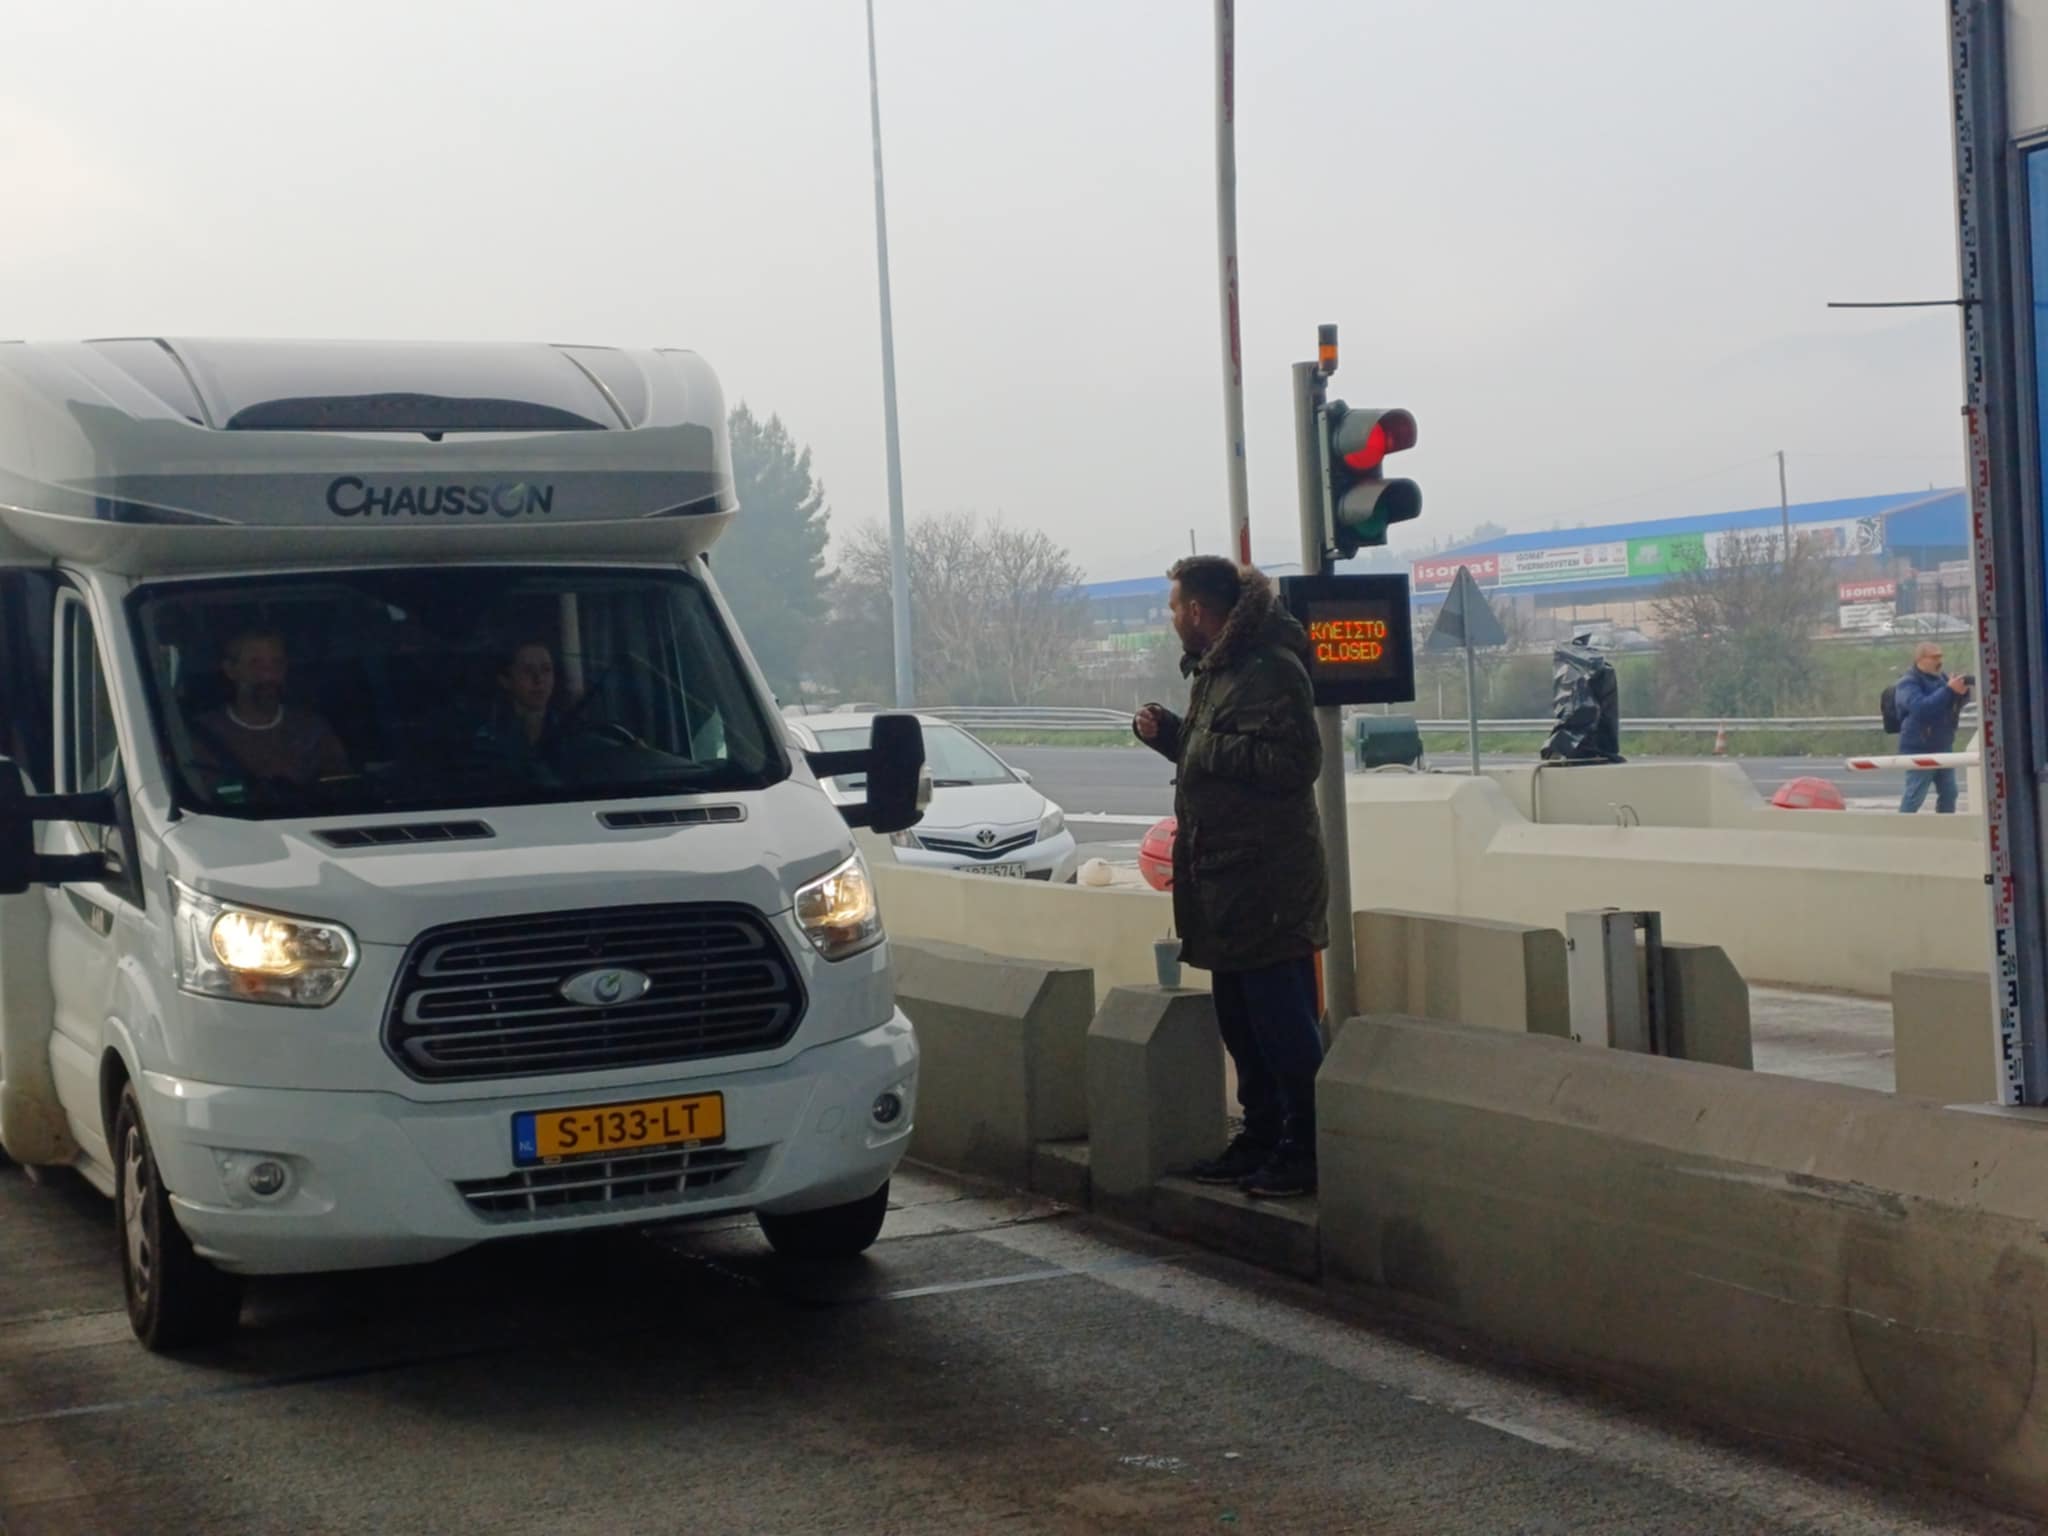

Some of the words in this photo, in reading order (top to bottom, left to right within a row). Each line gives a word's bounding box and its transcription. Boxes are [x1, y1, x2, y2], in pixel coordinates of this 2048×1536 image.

[1310, 620, 1387, 640] ΚΛΕΙΣΤΟ
[1316, 641, 1383, 661] CLOSED
[558, 1103, 700, 1148] S-133-LT
[519, 1141, 534, 1152] NL
